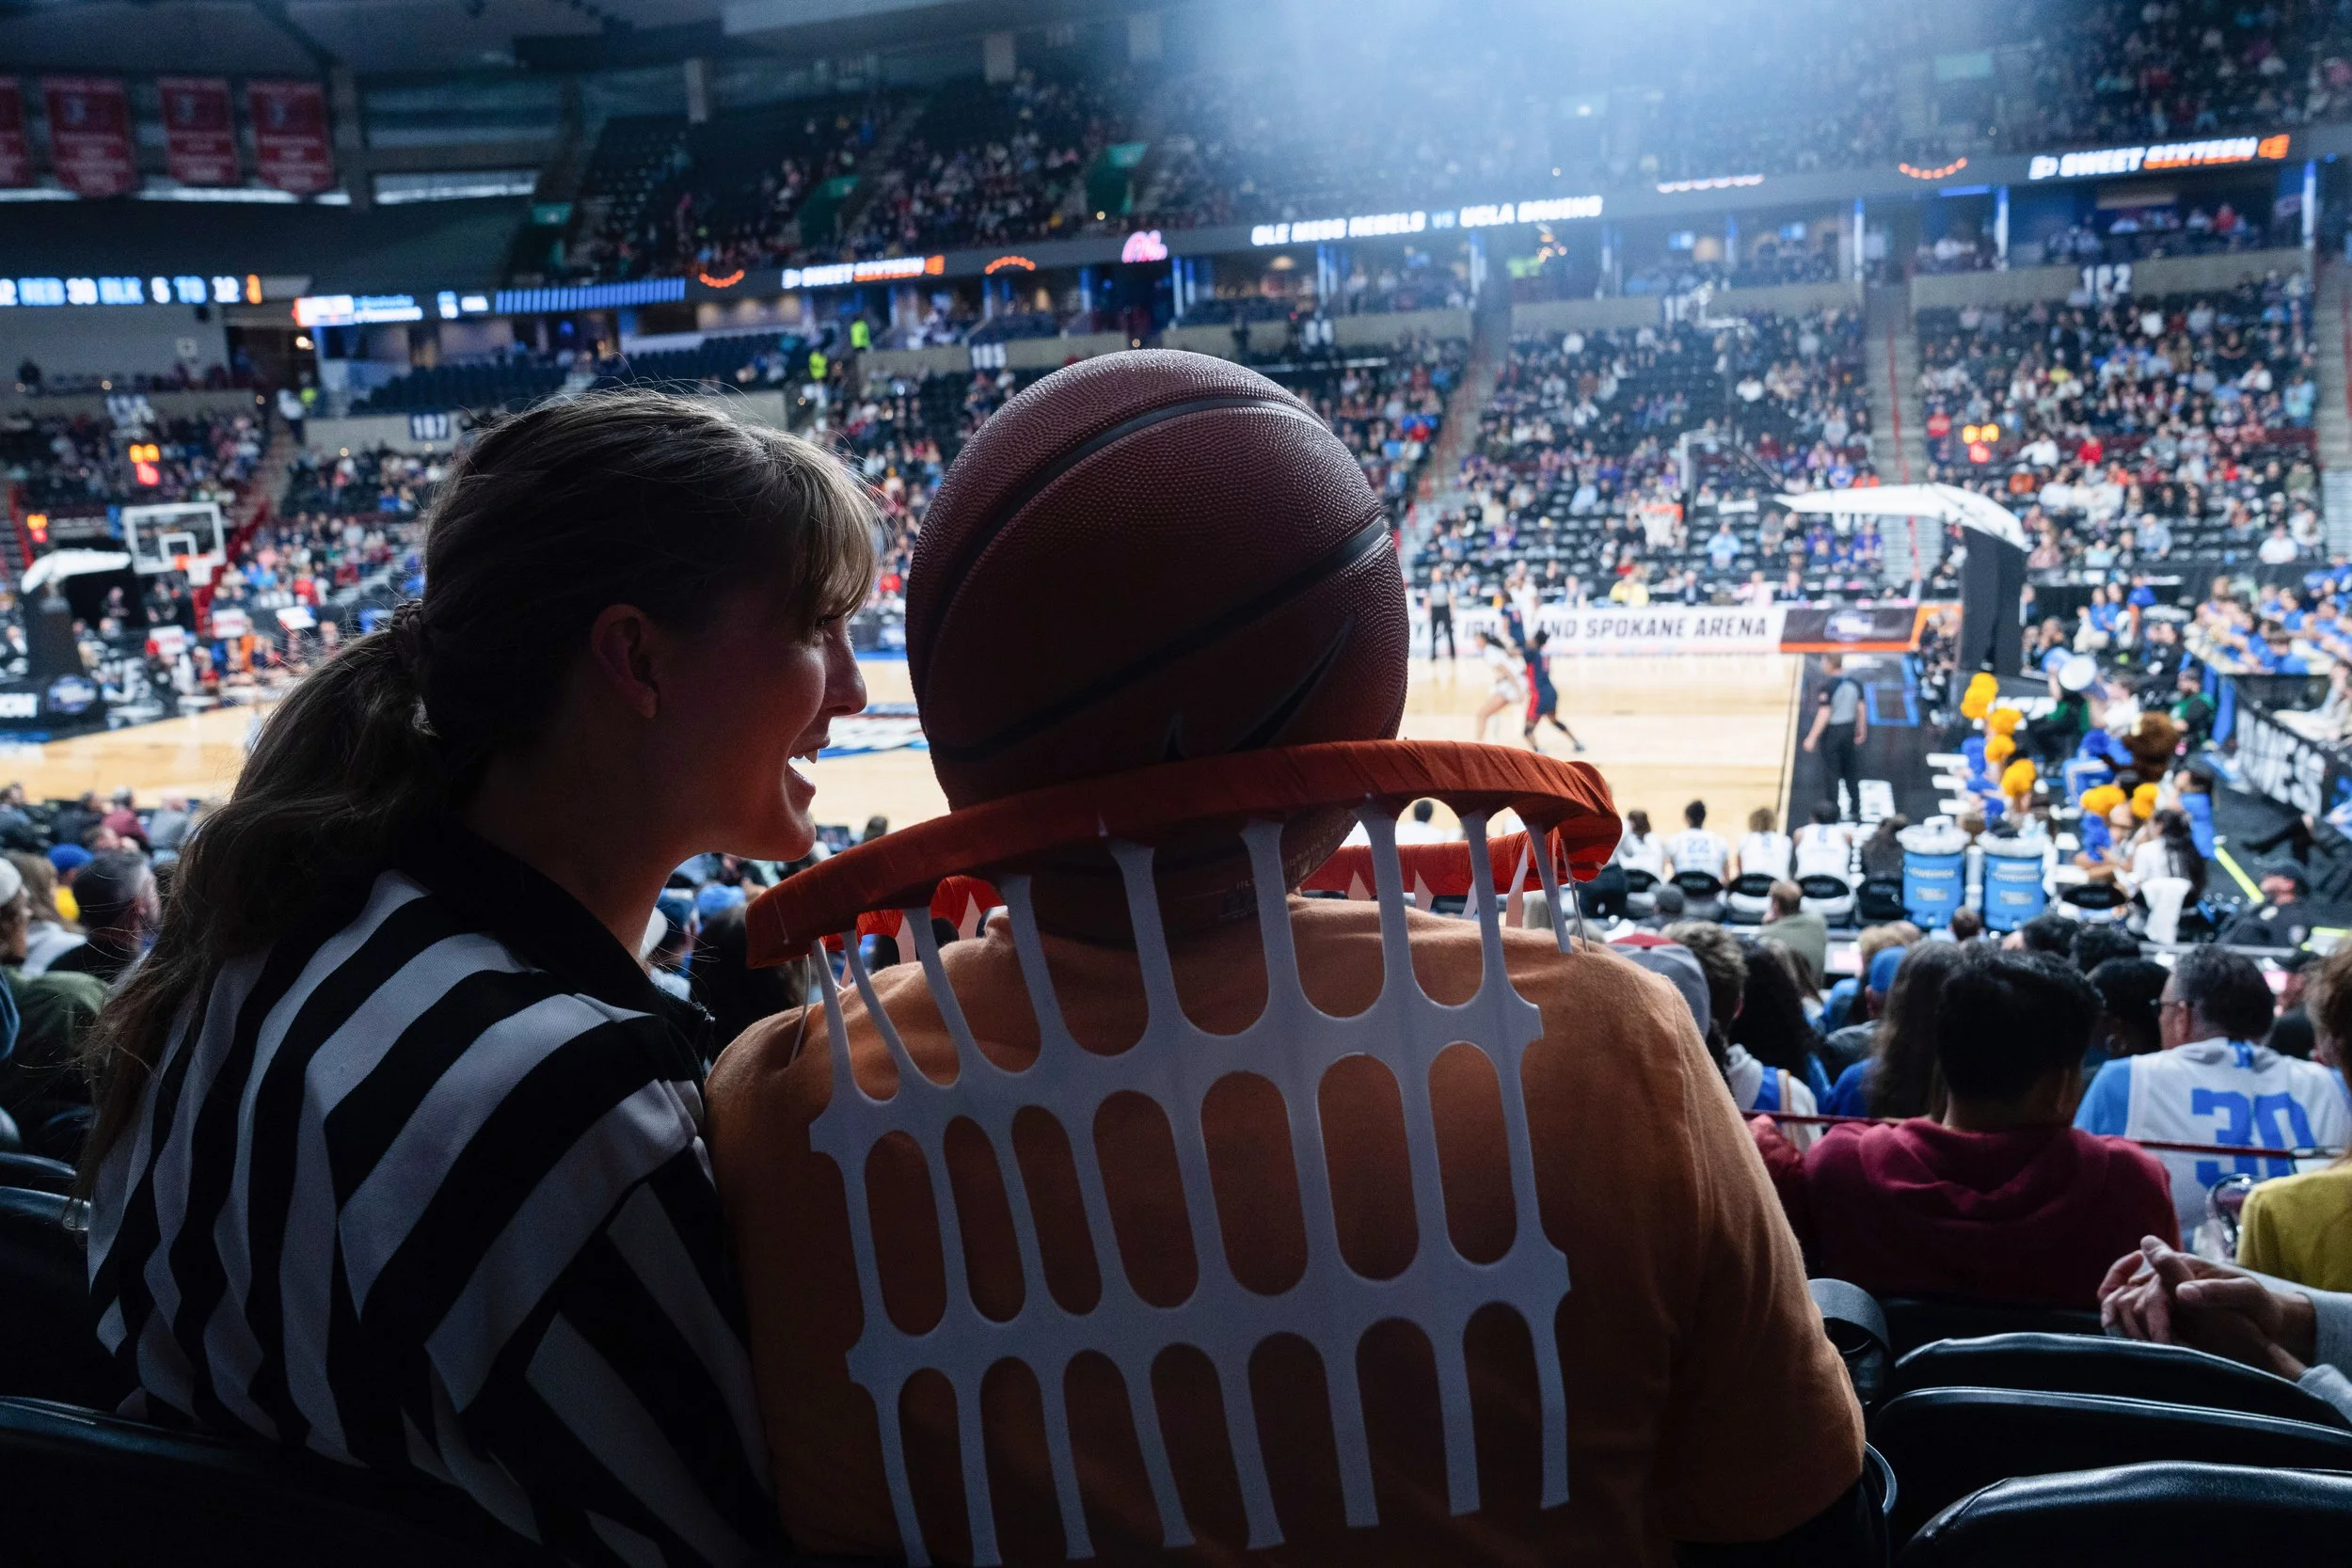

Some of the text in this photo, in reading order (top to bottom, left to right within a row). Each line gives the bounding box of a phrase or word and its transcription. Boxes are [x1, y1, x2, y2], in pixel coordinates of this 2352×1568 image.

[1585, 617, 1687, 639] SPOKANE
[1694, 616, 1768, 638] ARENA
[2191, 1087, 2318, 1189] 30
